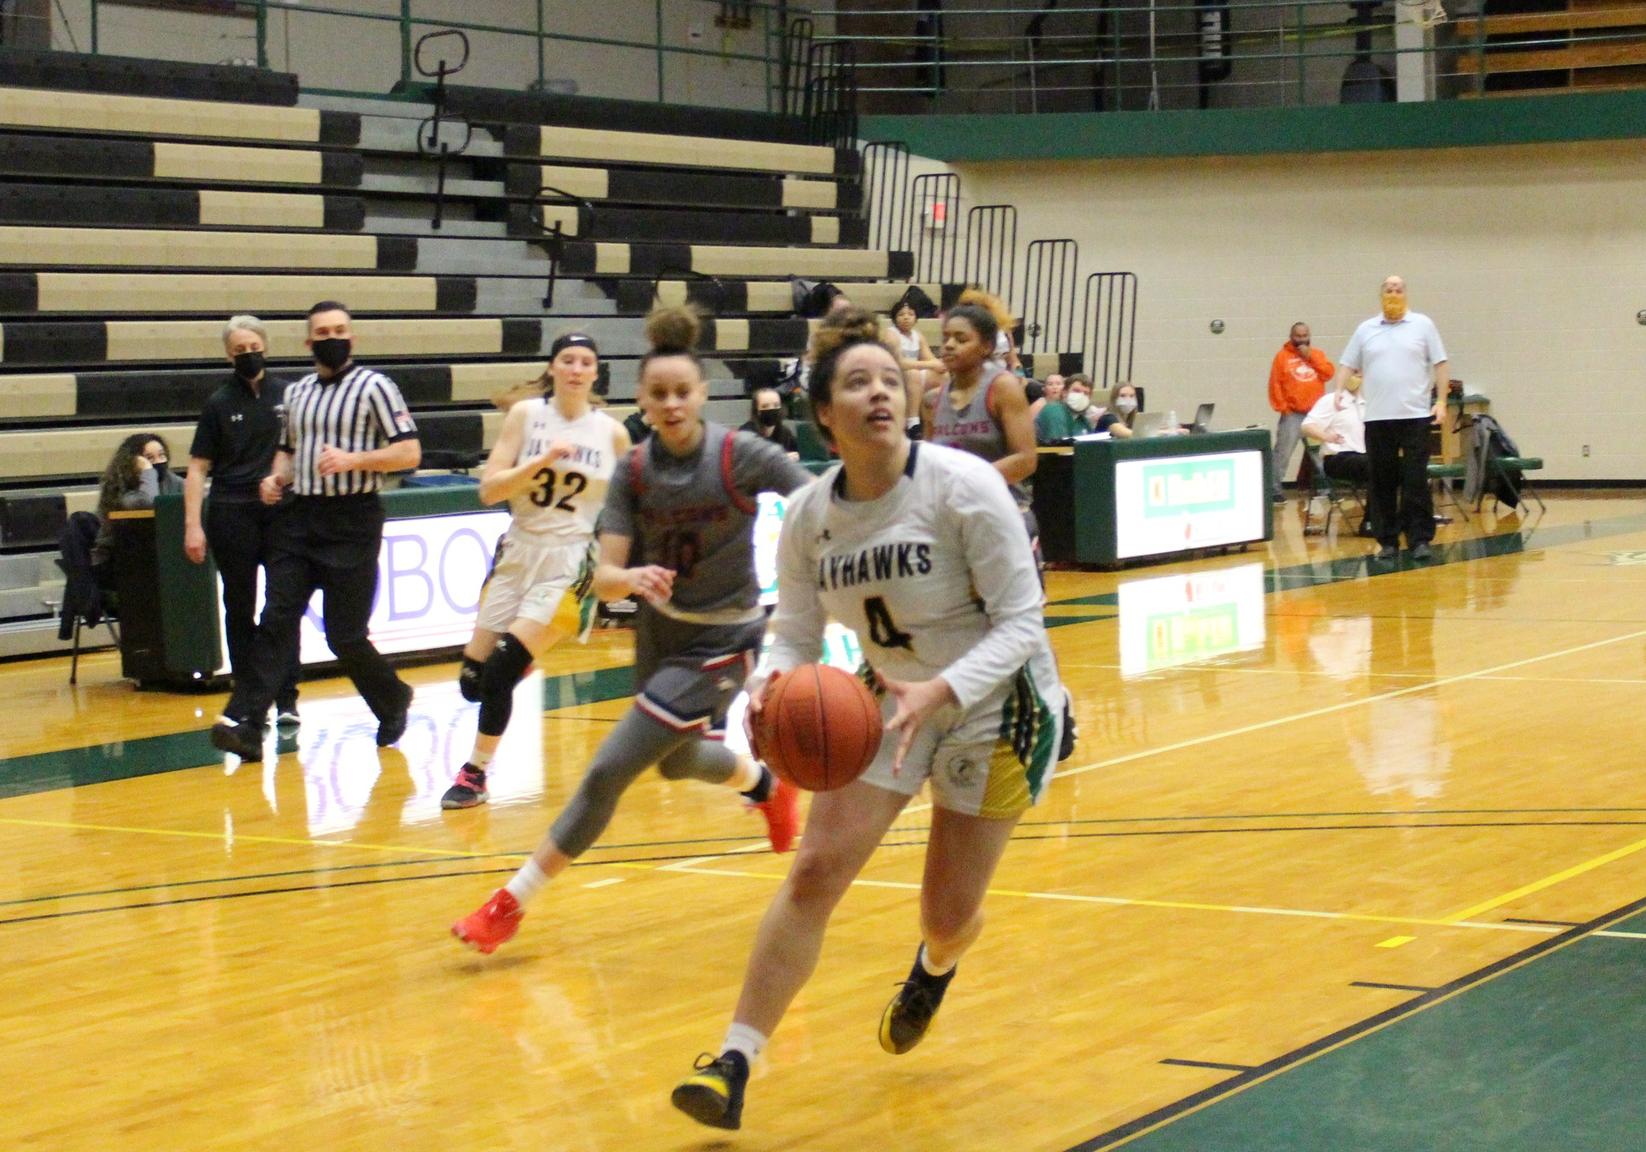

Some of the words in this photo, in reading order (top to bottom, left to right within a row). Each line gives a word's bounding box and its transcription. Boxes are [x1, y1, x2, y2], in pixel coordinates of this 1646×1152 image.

[529, 466, 587, 514] 32
[819, 543, 932, 592] AYHAWKS
[864, 595, 914, 652] 4
